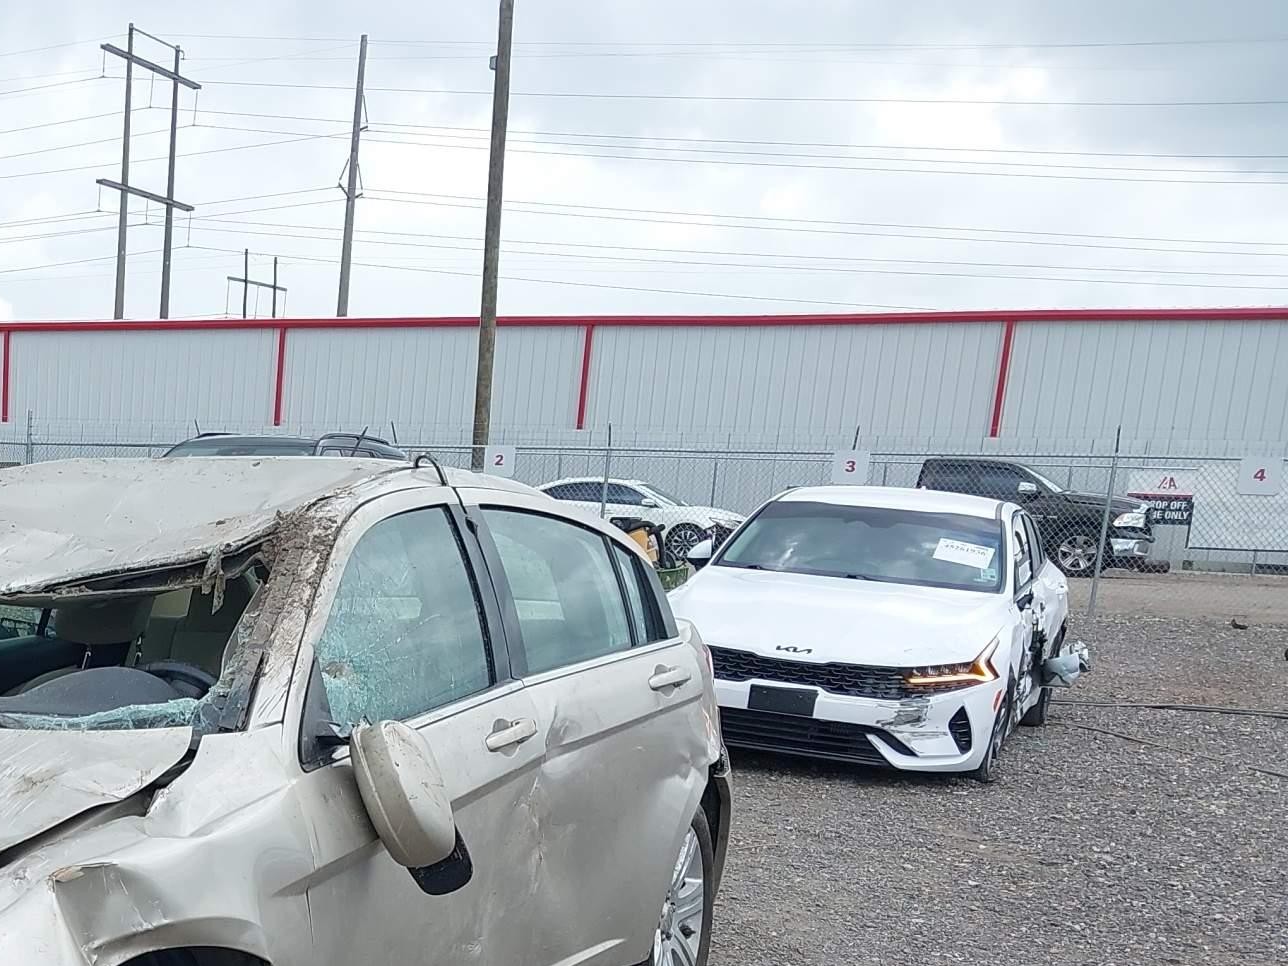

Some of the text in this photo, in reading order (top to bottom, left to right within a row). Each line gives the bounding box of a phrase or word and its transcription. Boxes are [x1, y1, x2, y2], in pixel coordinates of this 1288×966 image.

[494, 454, 504, 466] 2
[844, 460, 856, 473] 3
[1253, 468, 1267, 482] 4
[1170, 501, 1187, 510] OFF
[1164, 511, 1189, 520] ONLY
